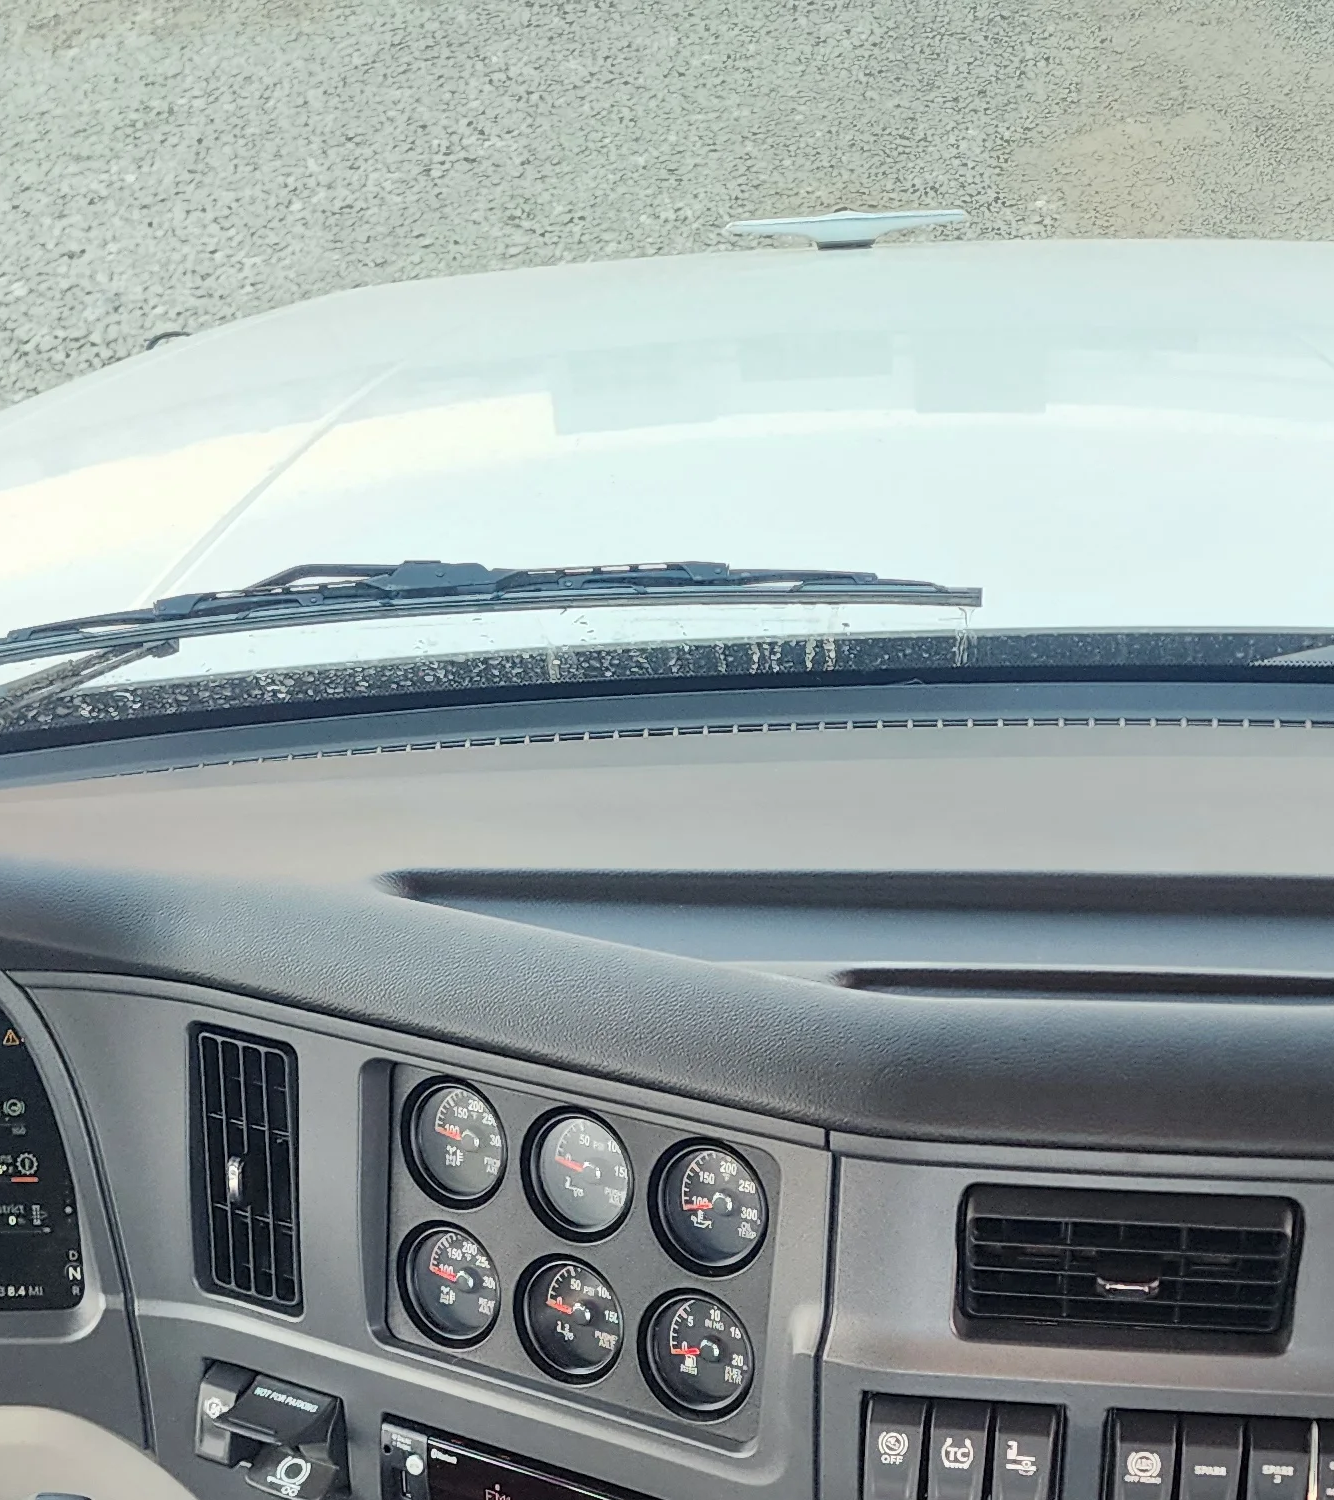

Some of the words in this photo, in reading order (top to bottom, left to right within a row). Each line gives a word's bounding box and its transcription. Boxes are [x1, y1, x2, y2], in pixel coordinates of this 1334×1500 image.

[453, 1106, 468, 1118] 150
[468, 1100, 484, 1112] 200
[579, 1134, 590, 1146] 50
[720, 1161, 737, 1175] 200
[699, 1171, 715, 1184] 150
[738, 1180, 755, 1193] 250
[741, 1207, 758, 1220] 300
[447, 1248, 462, 1261] 150
[462, 1241, 478, 1255] 200
[68, 1267, 82, 1281] N
[570, 1278, 582, 1291] 50
[687, 1316, 694, 1327] 5
[709, 1309, 721, 1321] 10
[732, 1353, 744, 1367] 20
[269, 1392, 287, 1403] FOR
[880, 1454, 903, 1465] OFF
[946, 1447, 969, 1462] TC
